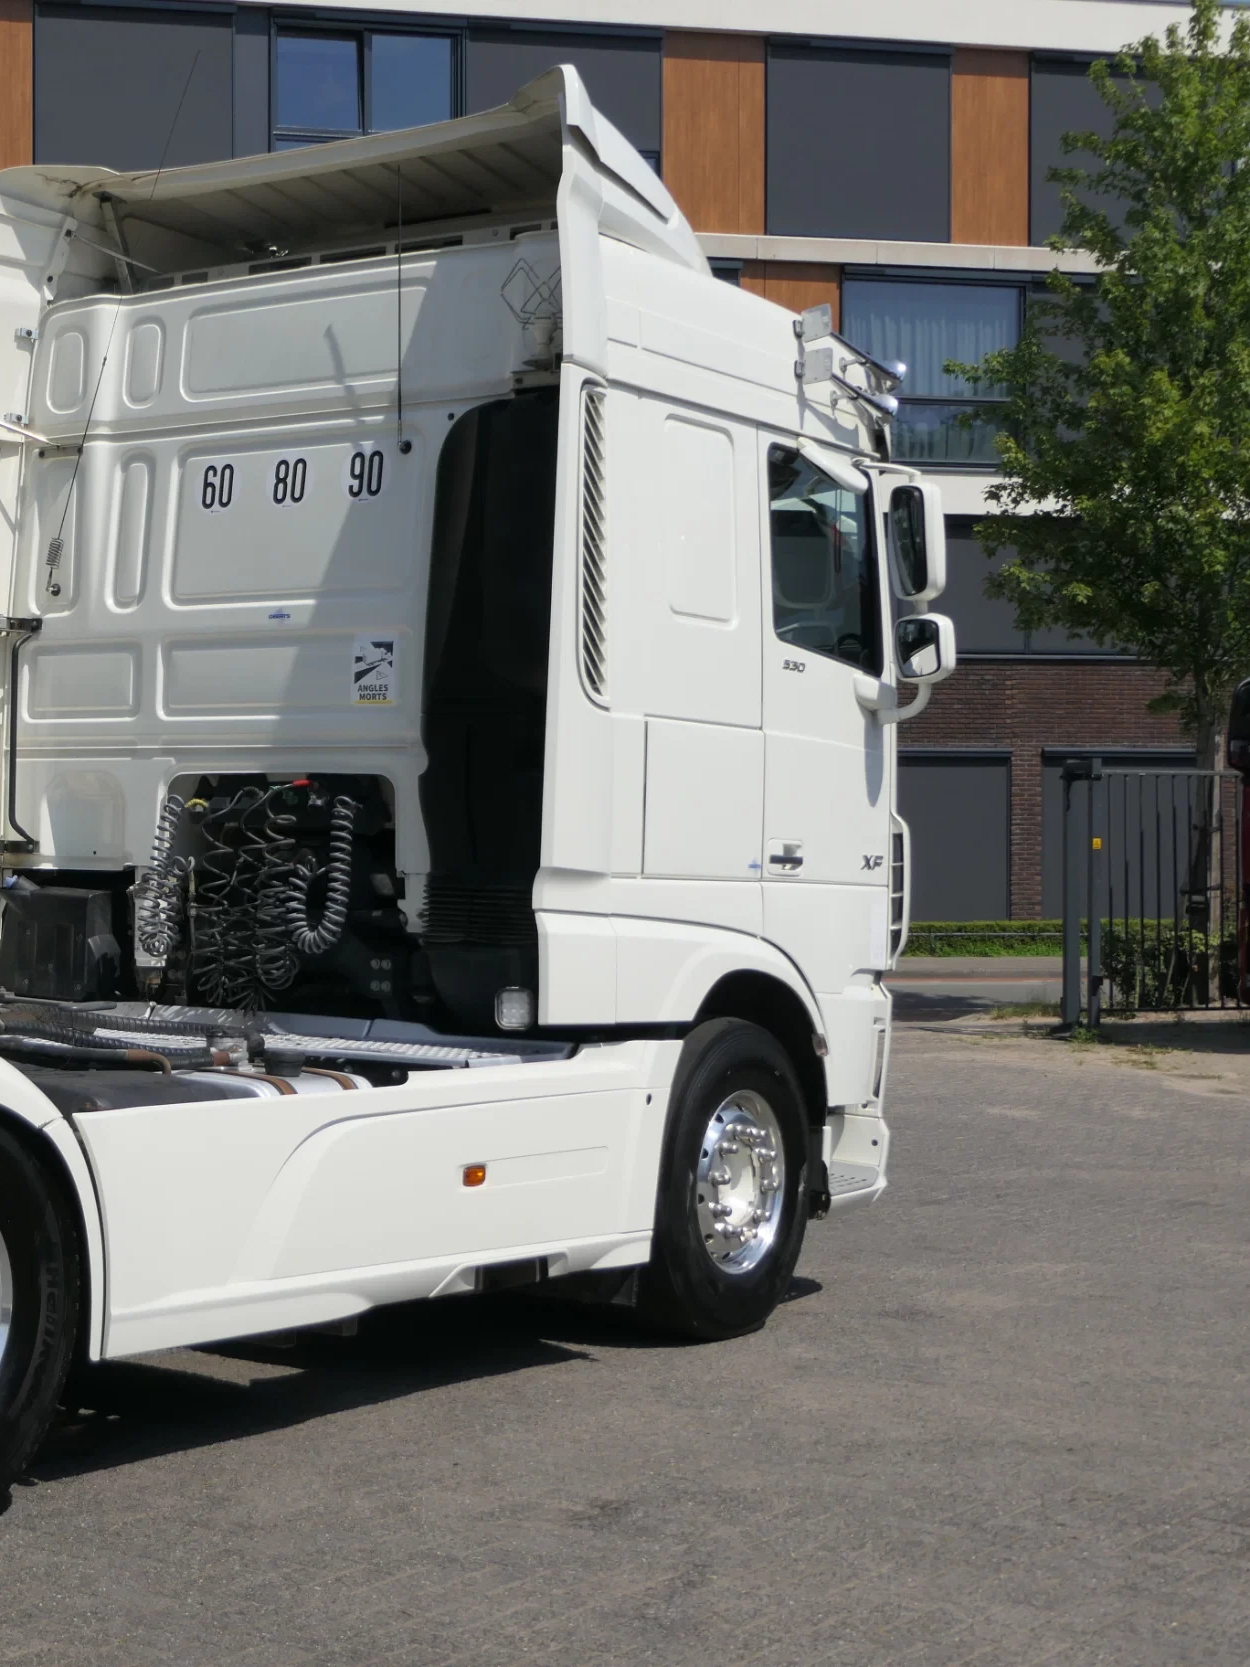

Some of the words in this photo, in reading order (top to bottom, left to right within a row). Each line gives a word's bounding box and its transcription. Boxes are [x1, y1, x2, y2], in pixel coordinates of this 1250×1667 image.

[273, 458, 307, 505] 80
[348, 450, 383, 498] 90
[201, 463, 234, 510] 60
[782, 659, 806, 673] 530
[357, 684, 389, 692] ANGLES
[359, 693, 387, 701] MORTS
[860, 855, 884, 871] XF
